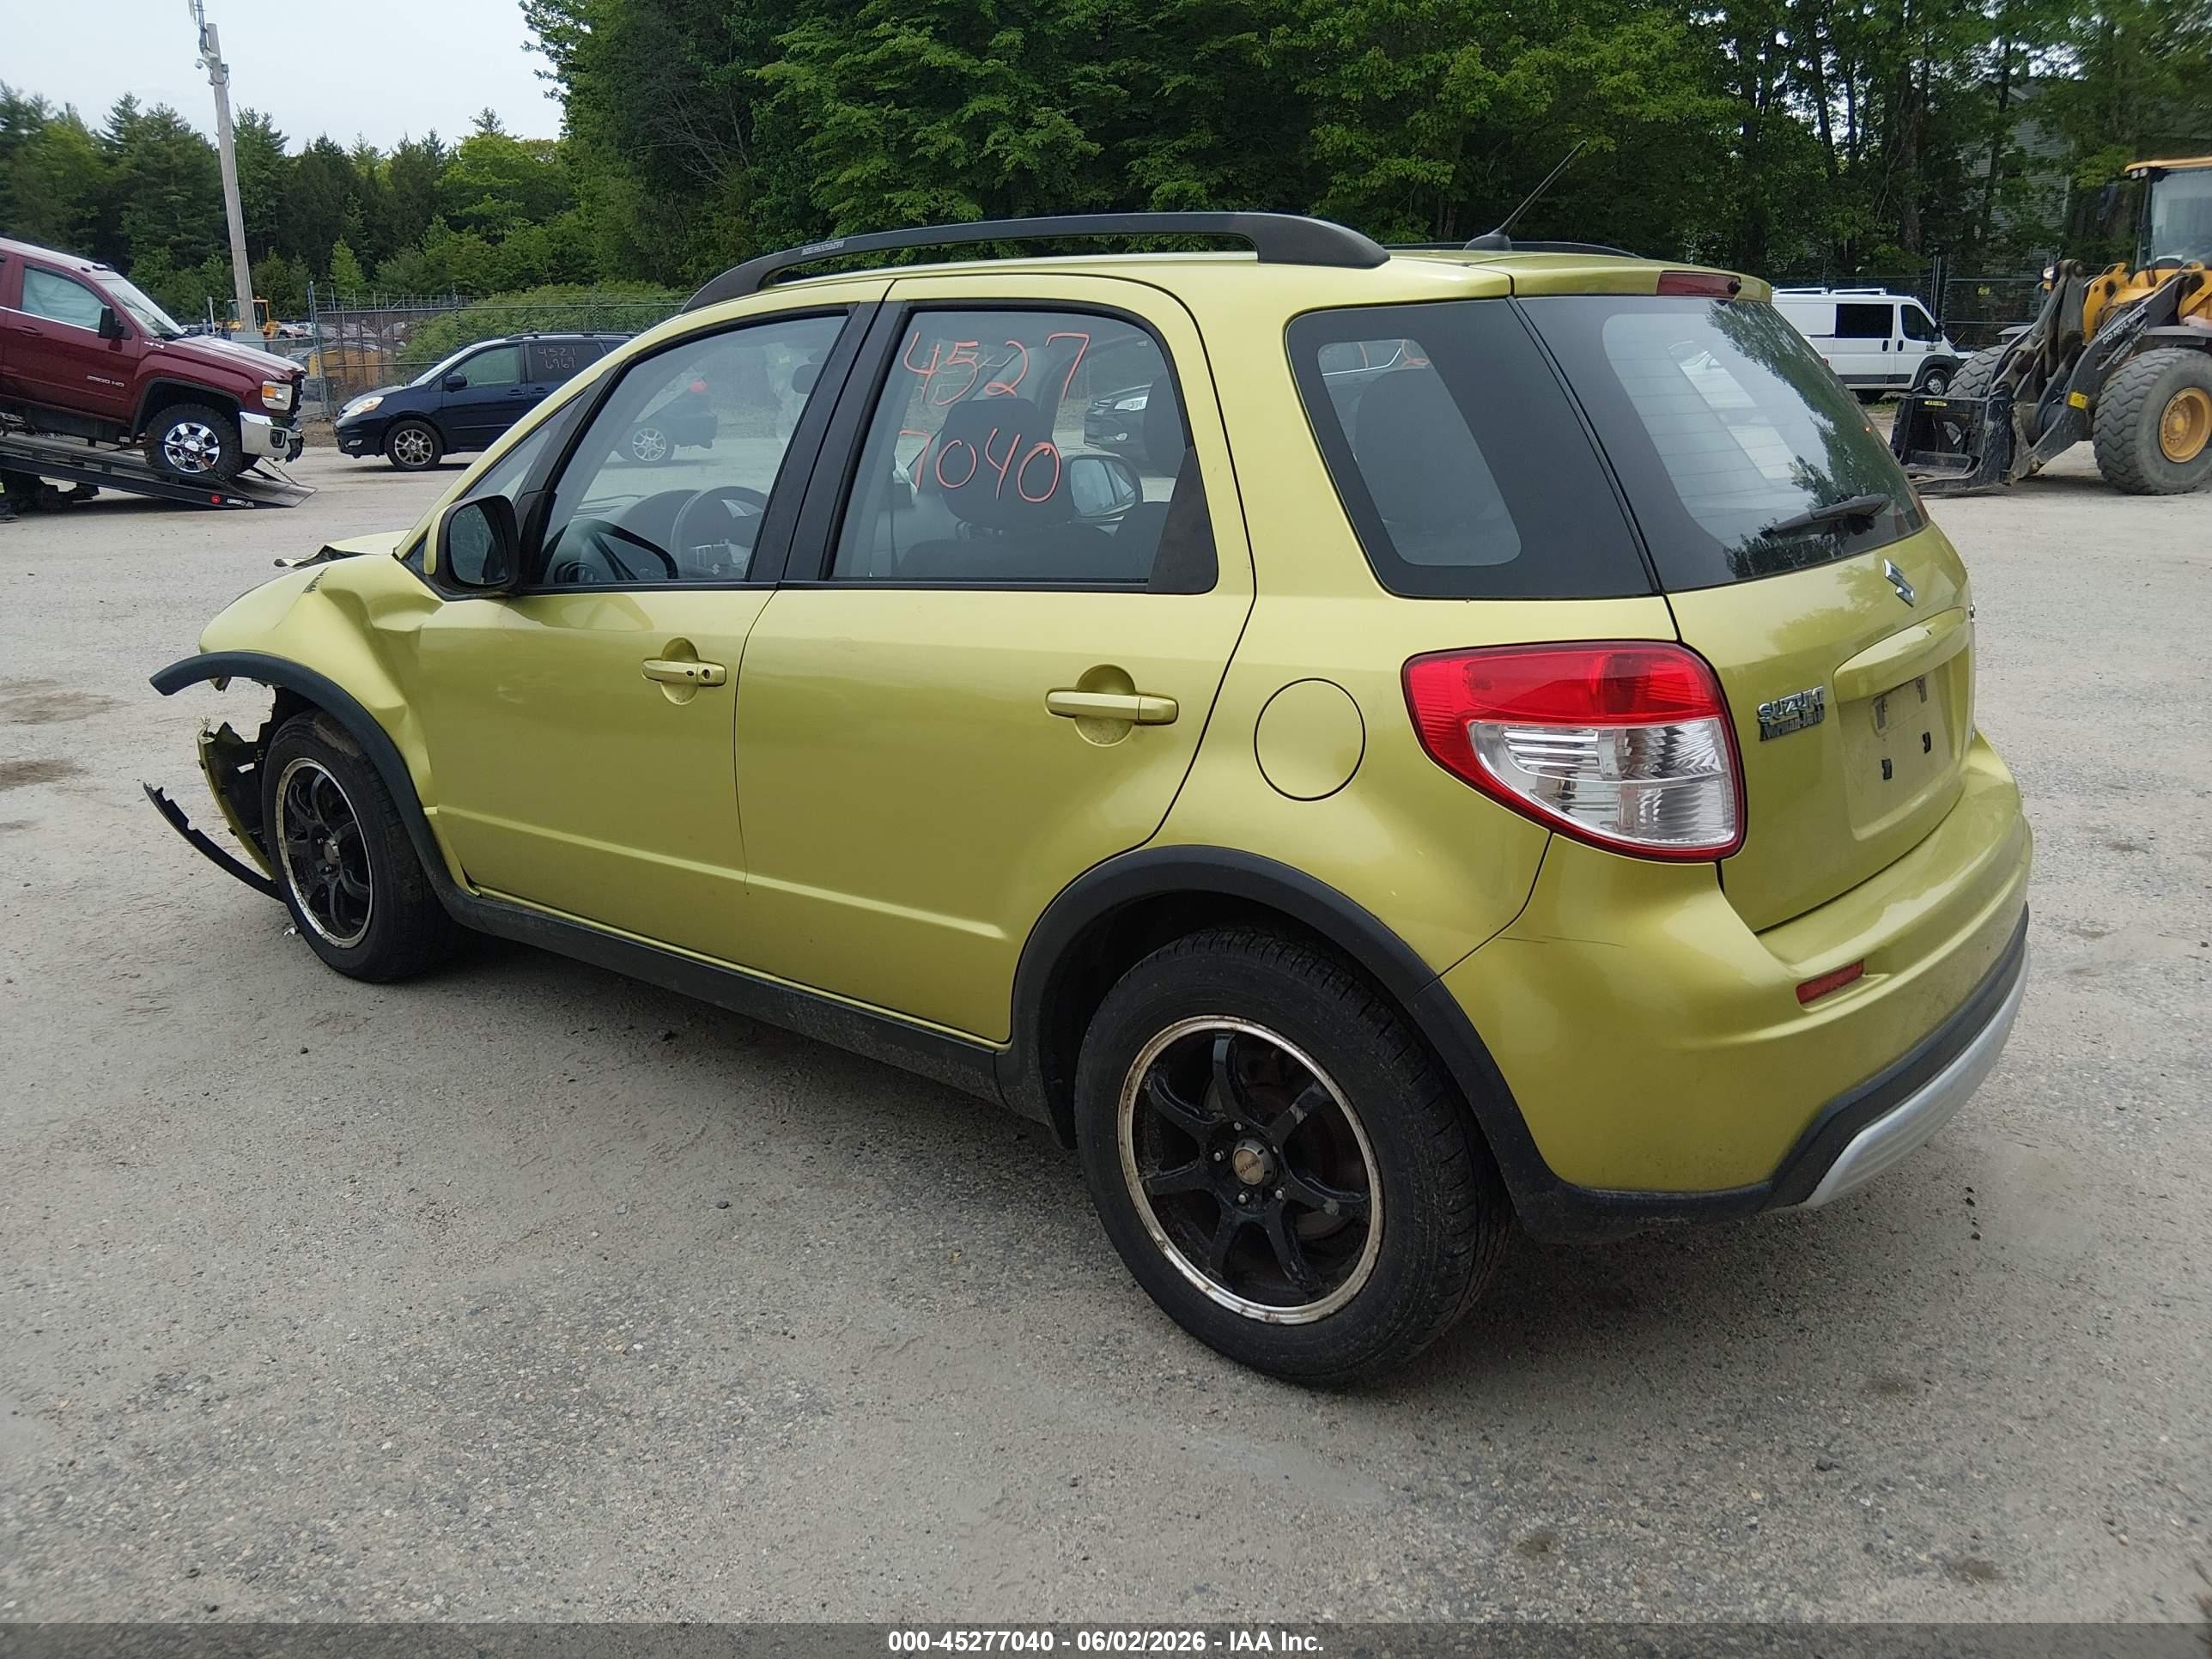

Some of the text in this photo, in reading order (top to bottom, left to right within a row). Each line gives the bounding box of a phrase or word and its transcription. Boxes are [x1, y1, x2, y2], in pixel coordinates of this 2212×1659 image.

[903, 331, 1091, 406] 4527
[899, 428, 1060, 502] 7040
[1757, 685, 1825, 723] SUZUKI
